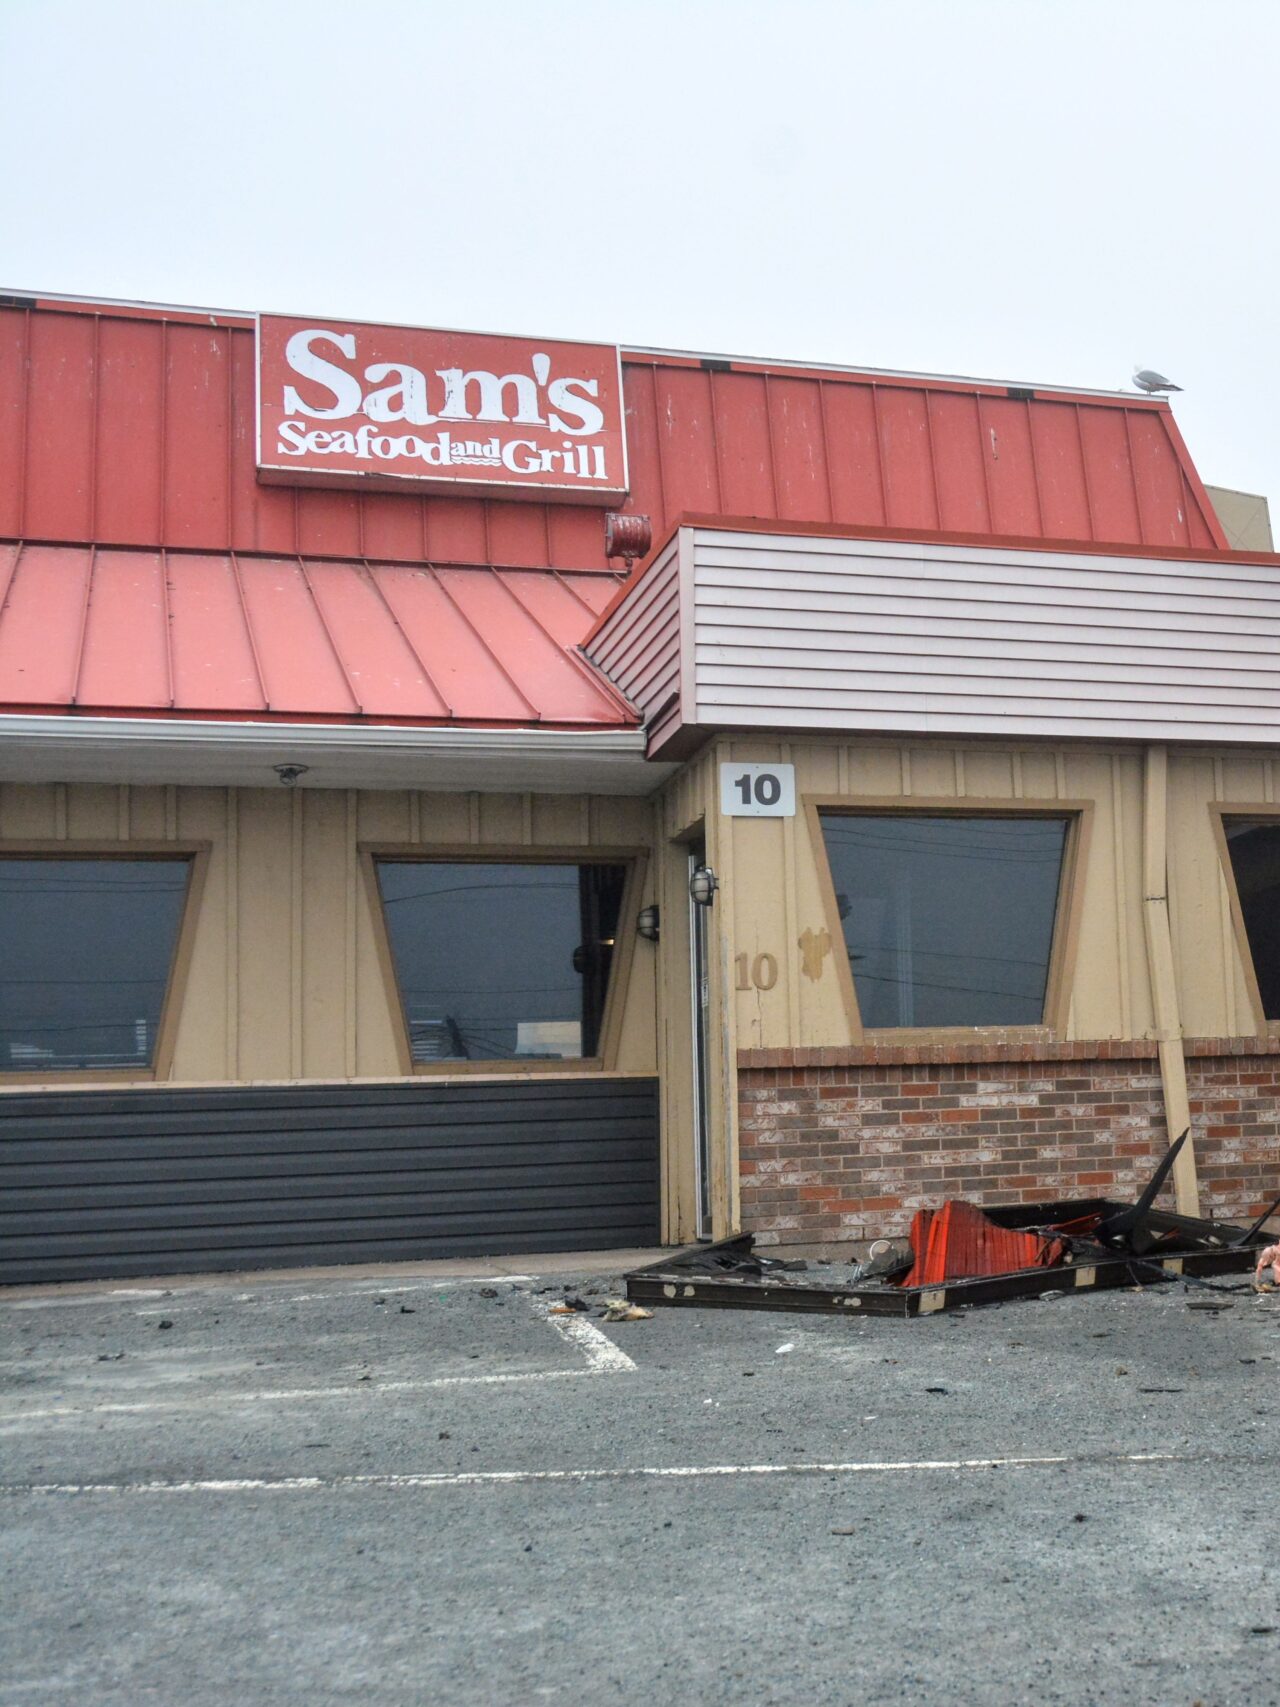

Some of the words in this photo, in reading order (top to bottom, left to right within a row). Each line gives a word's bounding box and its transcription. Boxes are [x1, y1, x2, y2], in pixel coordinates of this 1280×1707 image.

[284, 328, 604, 436] Sam's
[277, 421, 453, 466] Seafood
[451, 437, 502, 459] and
[501, 439, 609, 480] Grill
[734, 773, 782, 806] 10
[734, 952, 778, 991] 10
